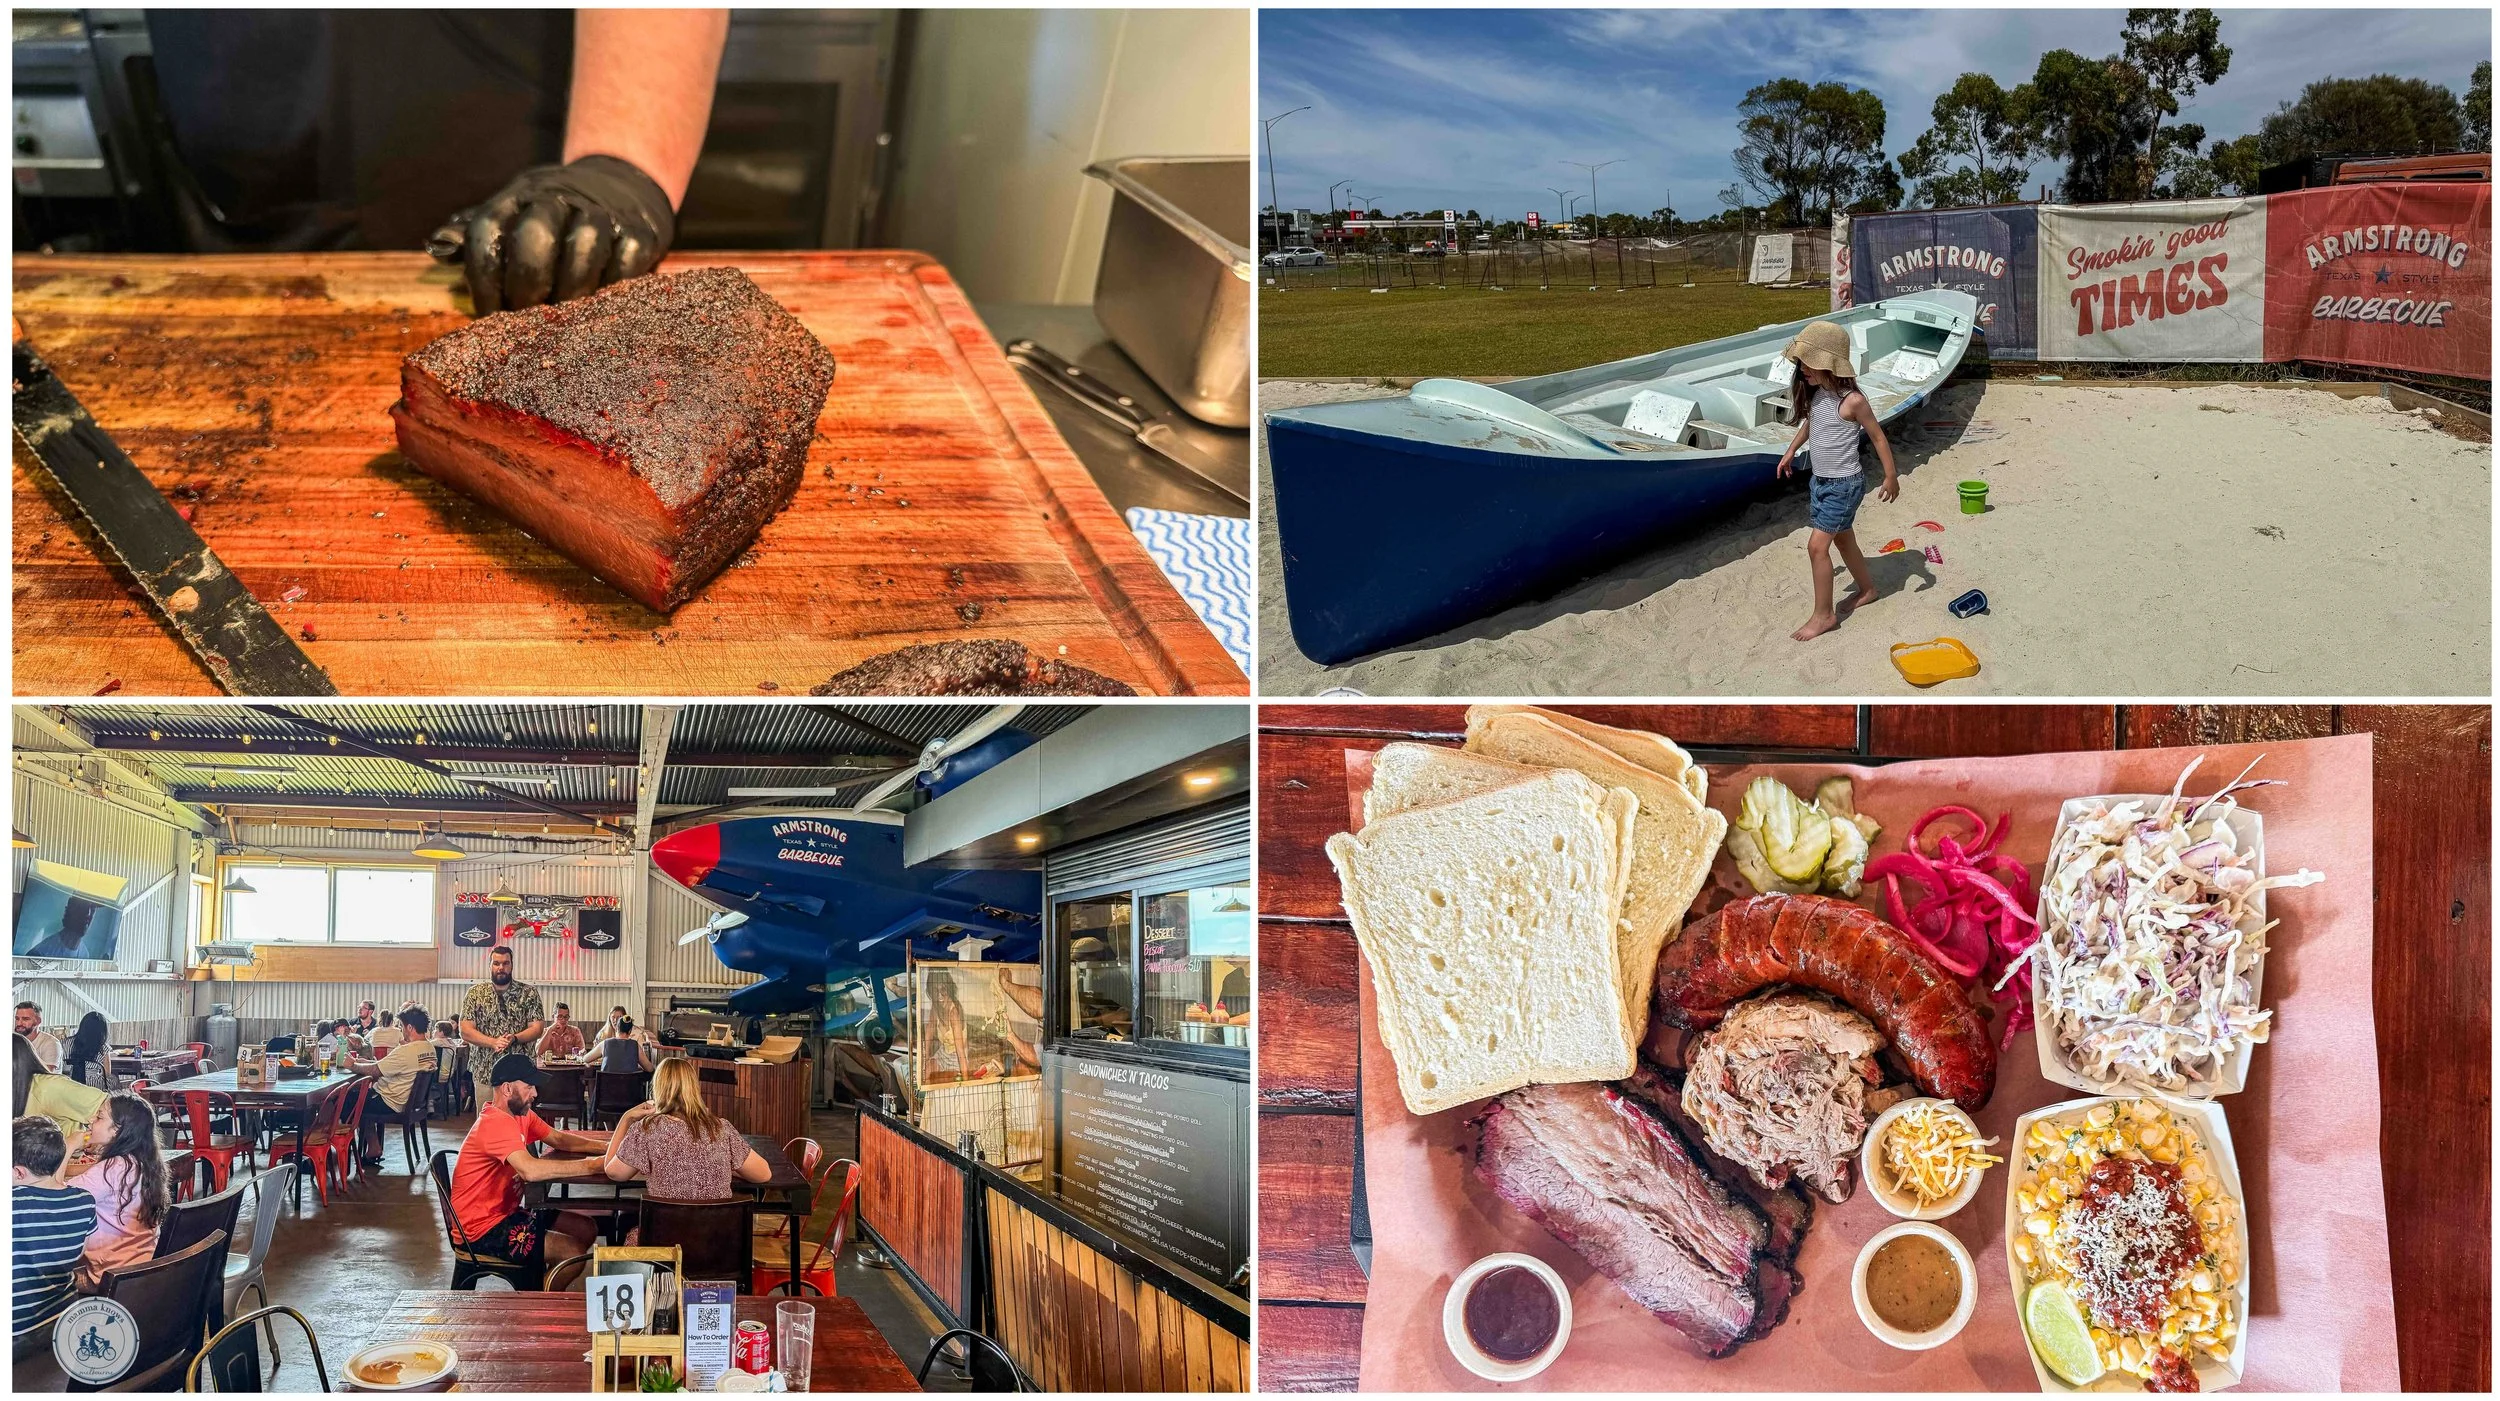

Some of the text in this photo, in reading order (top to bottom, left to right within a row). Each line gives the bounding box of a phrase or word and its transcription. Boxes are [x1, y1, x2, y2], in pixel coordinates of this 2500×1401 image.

[2067, 211, 2233, 280] Smokin' good
[2306, 225, 2469, 270] ARMSTRONG
[1880, 246, 2006, 284] ARMSTRONG
[1954, 284, 1985, 292] STYLE
[2326, 272, 2440, 284] TEXAS STYLE
[2070, 253, 2228, 336] TIMES
[2311, 295, 2454, 328] BARBECUE
[772, 820, 848, 843] ARMSTRONG
[778, 848, 845, 867] BARBECUE
[527, 896, 550, 904] BBQ
[518, 908, 558, 918] TEXAS
[1078, 1062, 1127, 1082] SANDWICHES
[1138, 1072, 1170, 1090] TACOS
[1159, 1134, 1176, 1144] POTATO
[1116, 1208, 1138, 1225] POTATO
[596, 1284, 634, 1322] 18
